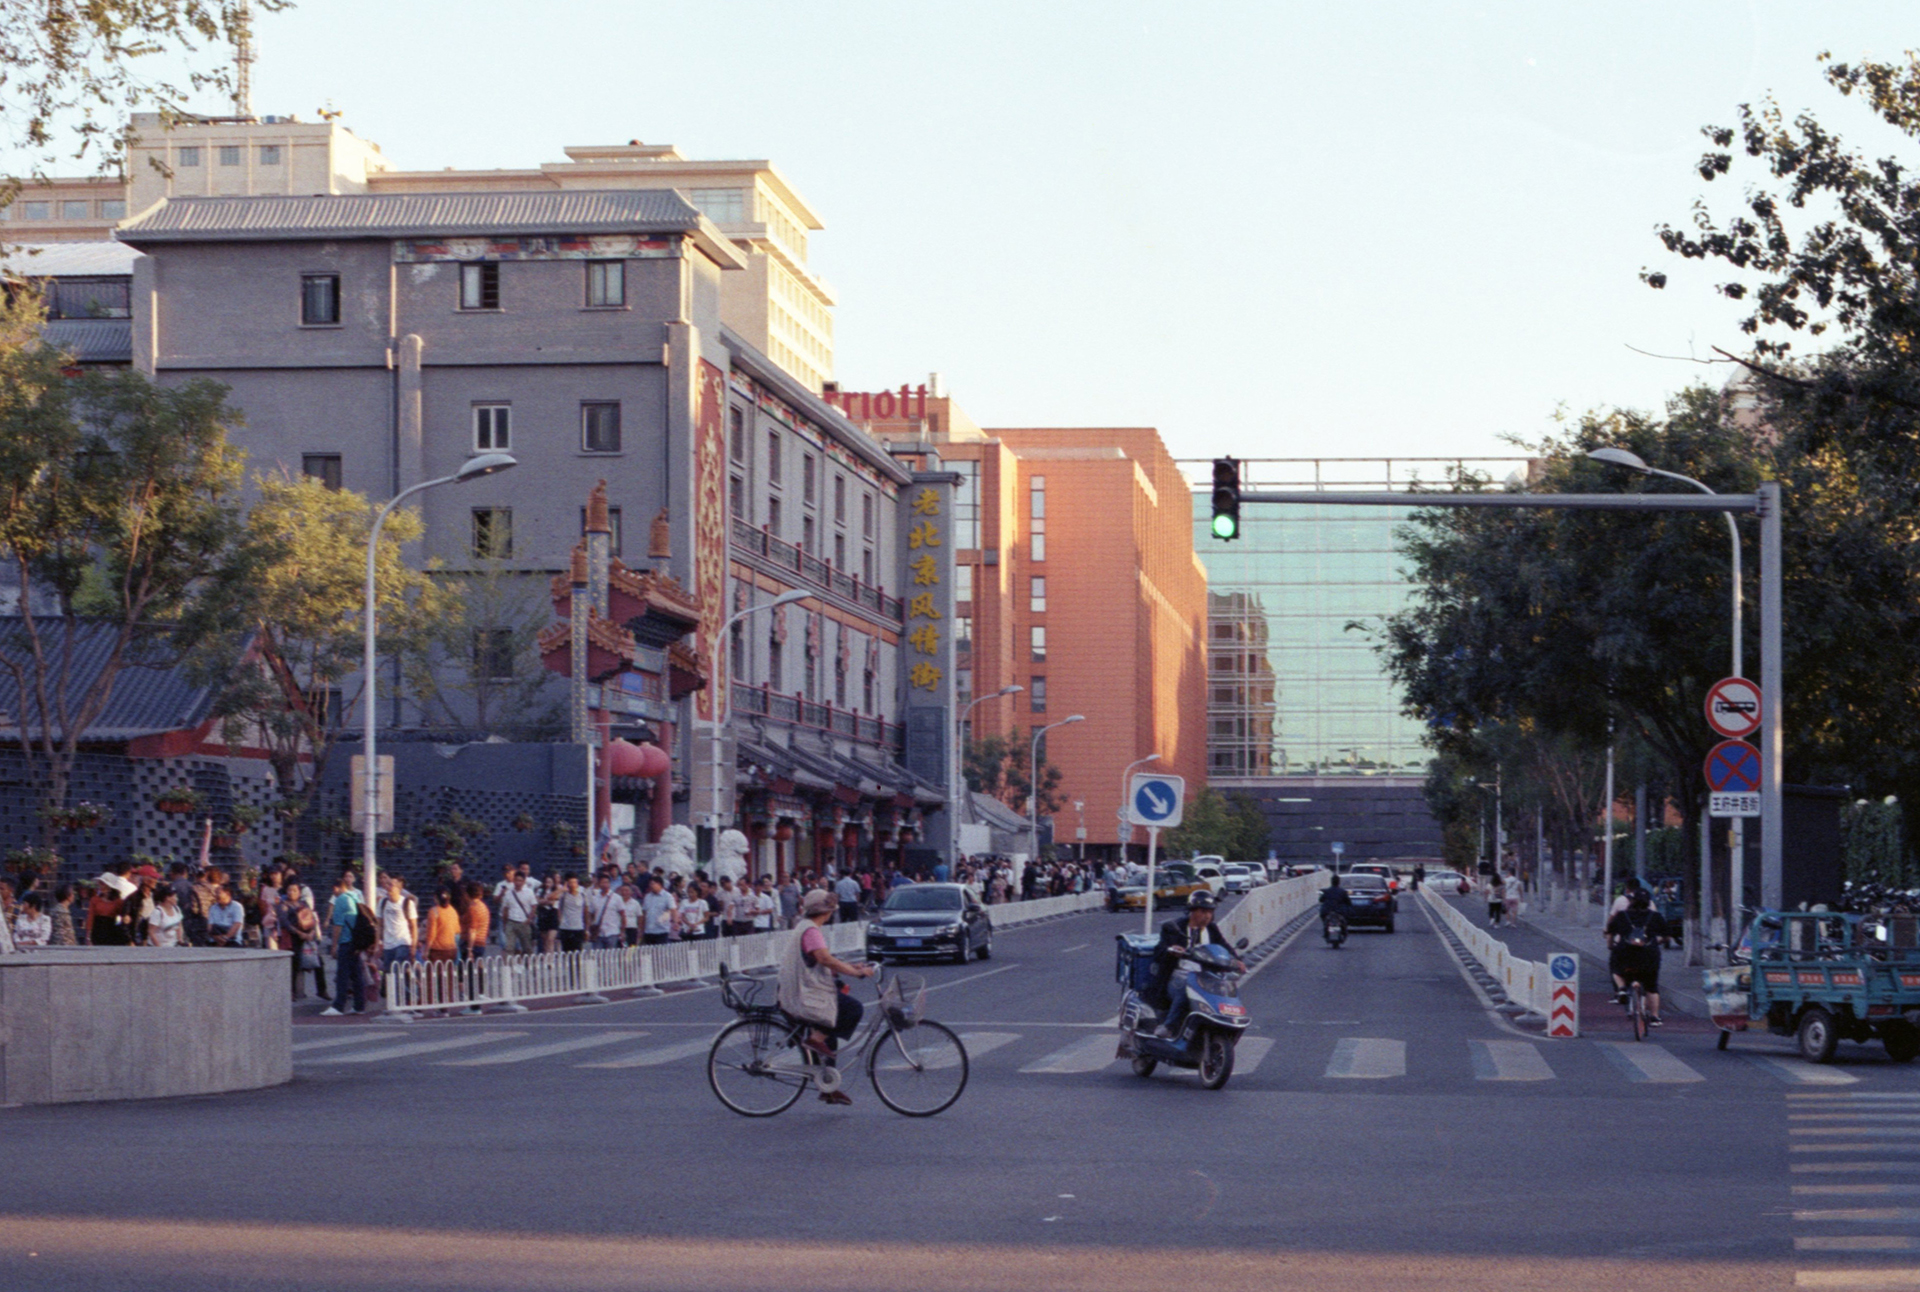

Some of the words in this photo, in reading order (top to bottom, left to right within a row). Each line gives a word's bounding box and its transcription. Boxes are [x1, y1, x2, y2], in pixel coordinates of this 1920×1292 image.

[908, 487, 943, 692] 老北京风情街
